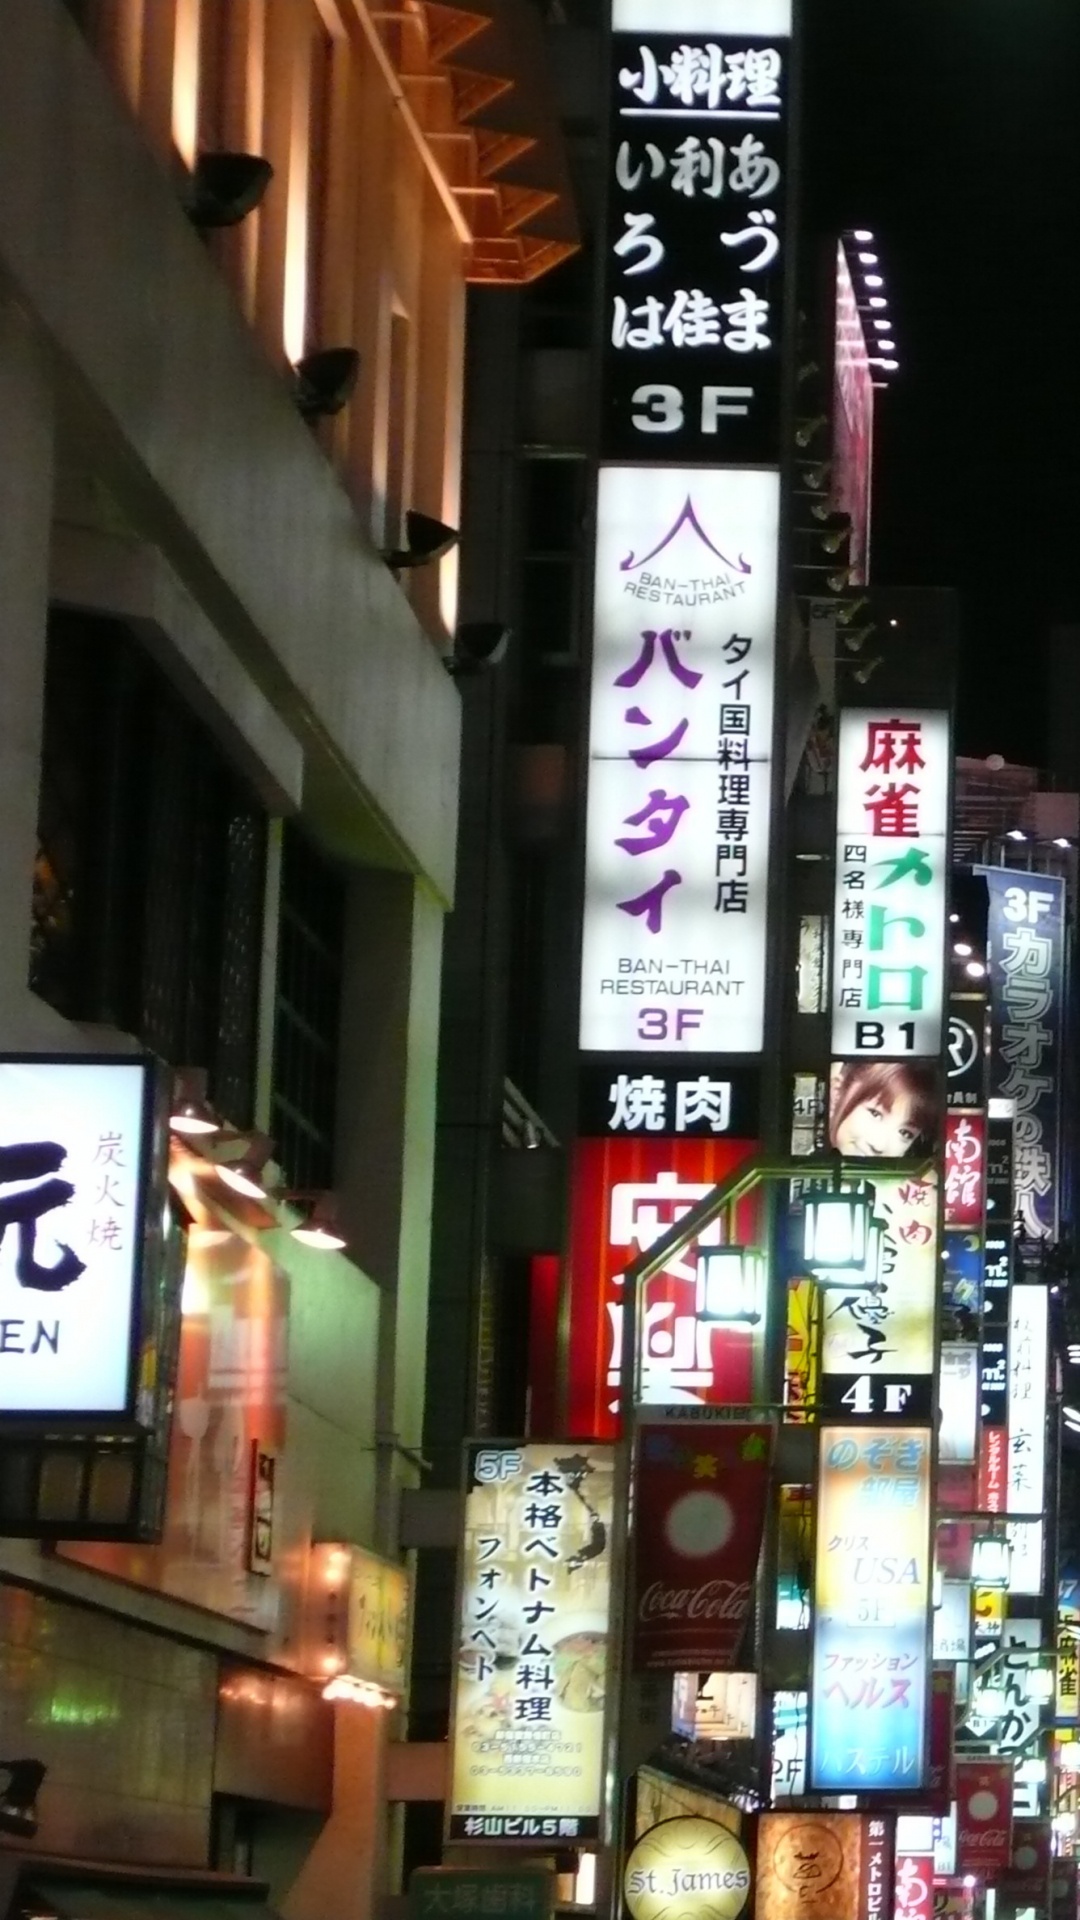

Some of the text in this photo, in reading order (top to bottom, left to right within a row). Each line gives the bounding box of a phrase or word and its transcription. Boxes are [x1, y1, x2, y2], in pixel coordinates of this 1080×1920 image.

[618, 43, 782, 109] 小料理
[611, 140, 665, 348] いろは
[719, 133, 781, 353] あづま
[630, 384, 754, 434] 3F
[623, 580, 746, 607] RESTAURANT
[638, 570, 732, 592] BAN-THAI
[613, 628, 704, 934] バンタイ
[714, 633, 752, 914] タイ国料理専門店
[859, 718, 926, 838] 麻雀
[1003, 887, 1054, 923] 3F
[839, 845, 867, 1009] 四名様専門店
[618, 958, 731, 976] BAN-THAI
[601, 979, 745, 996] RESTAURANT
[637, 1008, 704, 1041] 3F
[855, 1021, 916, 1050] B1
[999, 927, 1053, 1240] カラオケの鉄人
[608, 1074, 732, 1132] 焼肉
[840, 1375, 913, 1414] 4F
[475, 1450, 523, 1482] 5F
[828, 1437, 922, 1472] のぞき
[828, 1535, 869, 1552] クリス
[853, 1557, 921, 1585] USA
[514, 1470, 564, 1722] 本格ベトナム料理
[639, 1579, 752, 1622] Coca-Cola
[823, 1652, 918, 1672] ファッション
[823, 1677, 912, 1710] ヘルス
[464, 1816, 580, 1837] 杉山ビル5階
[667, 1868, 749, 1896] James
